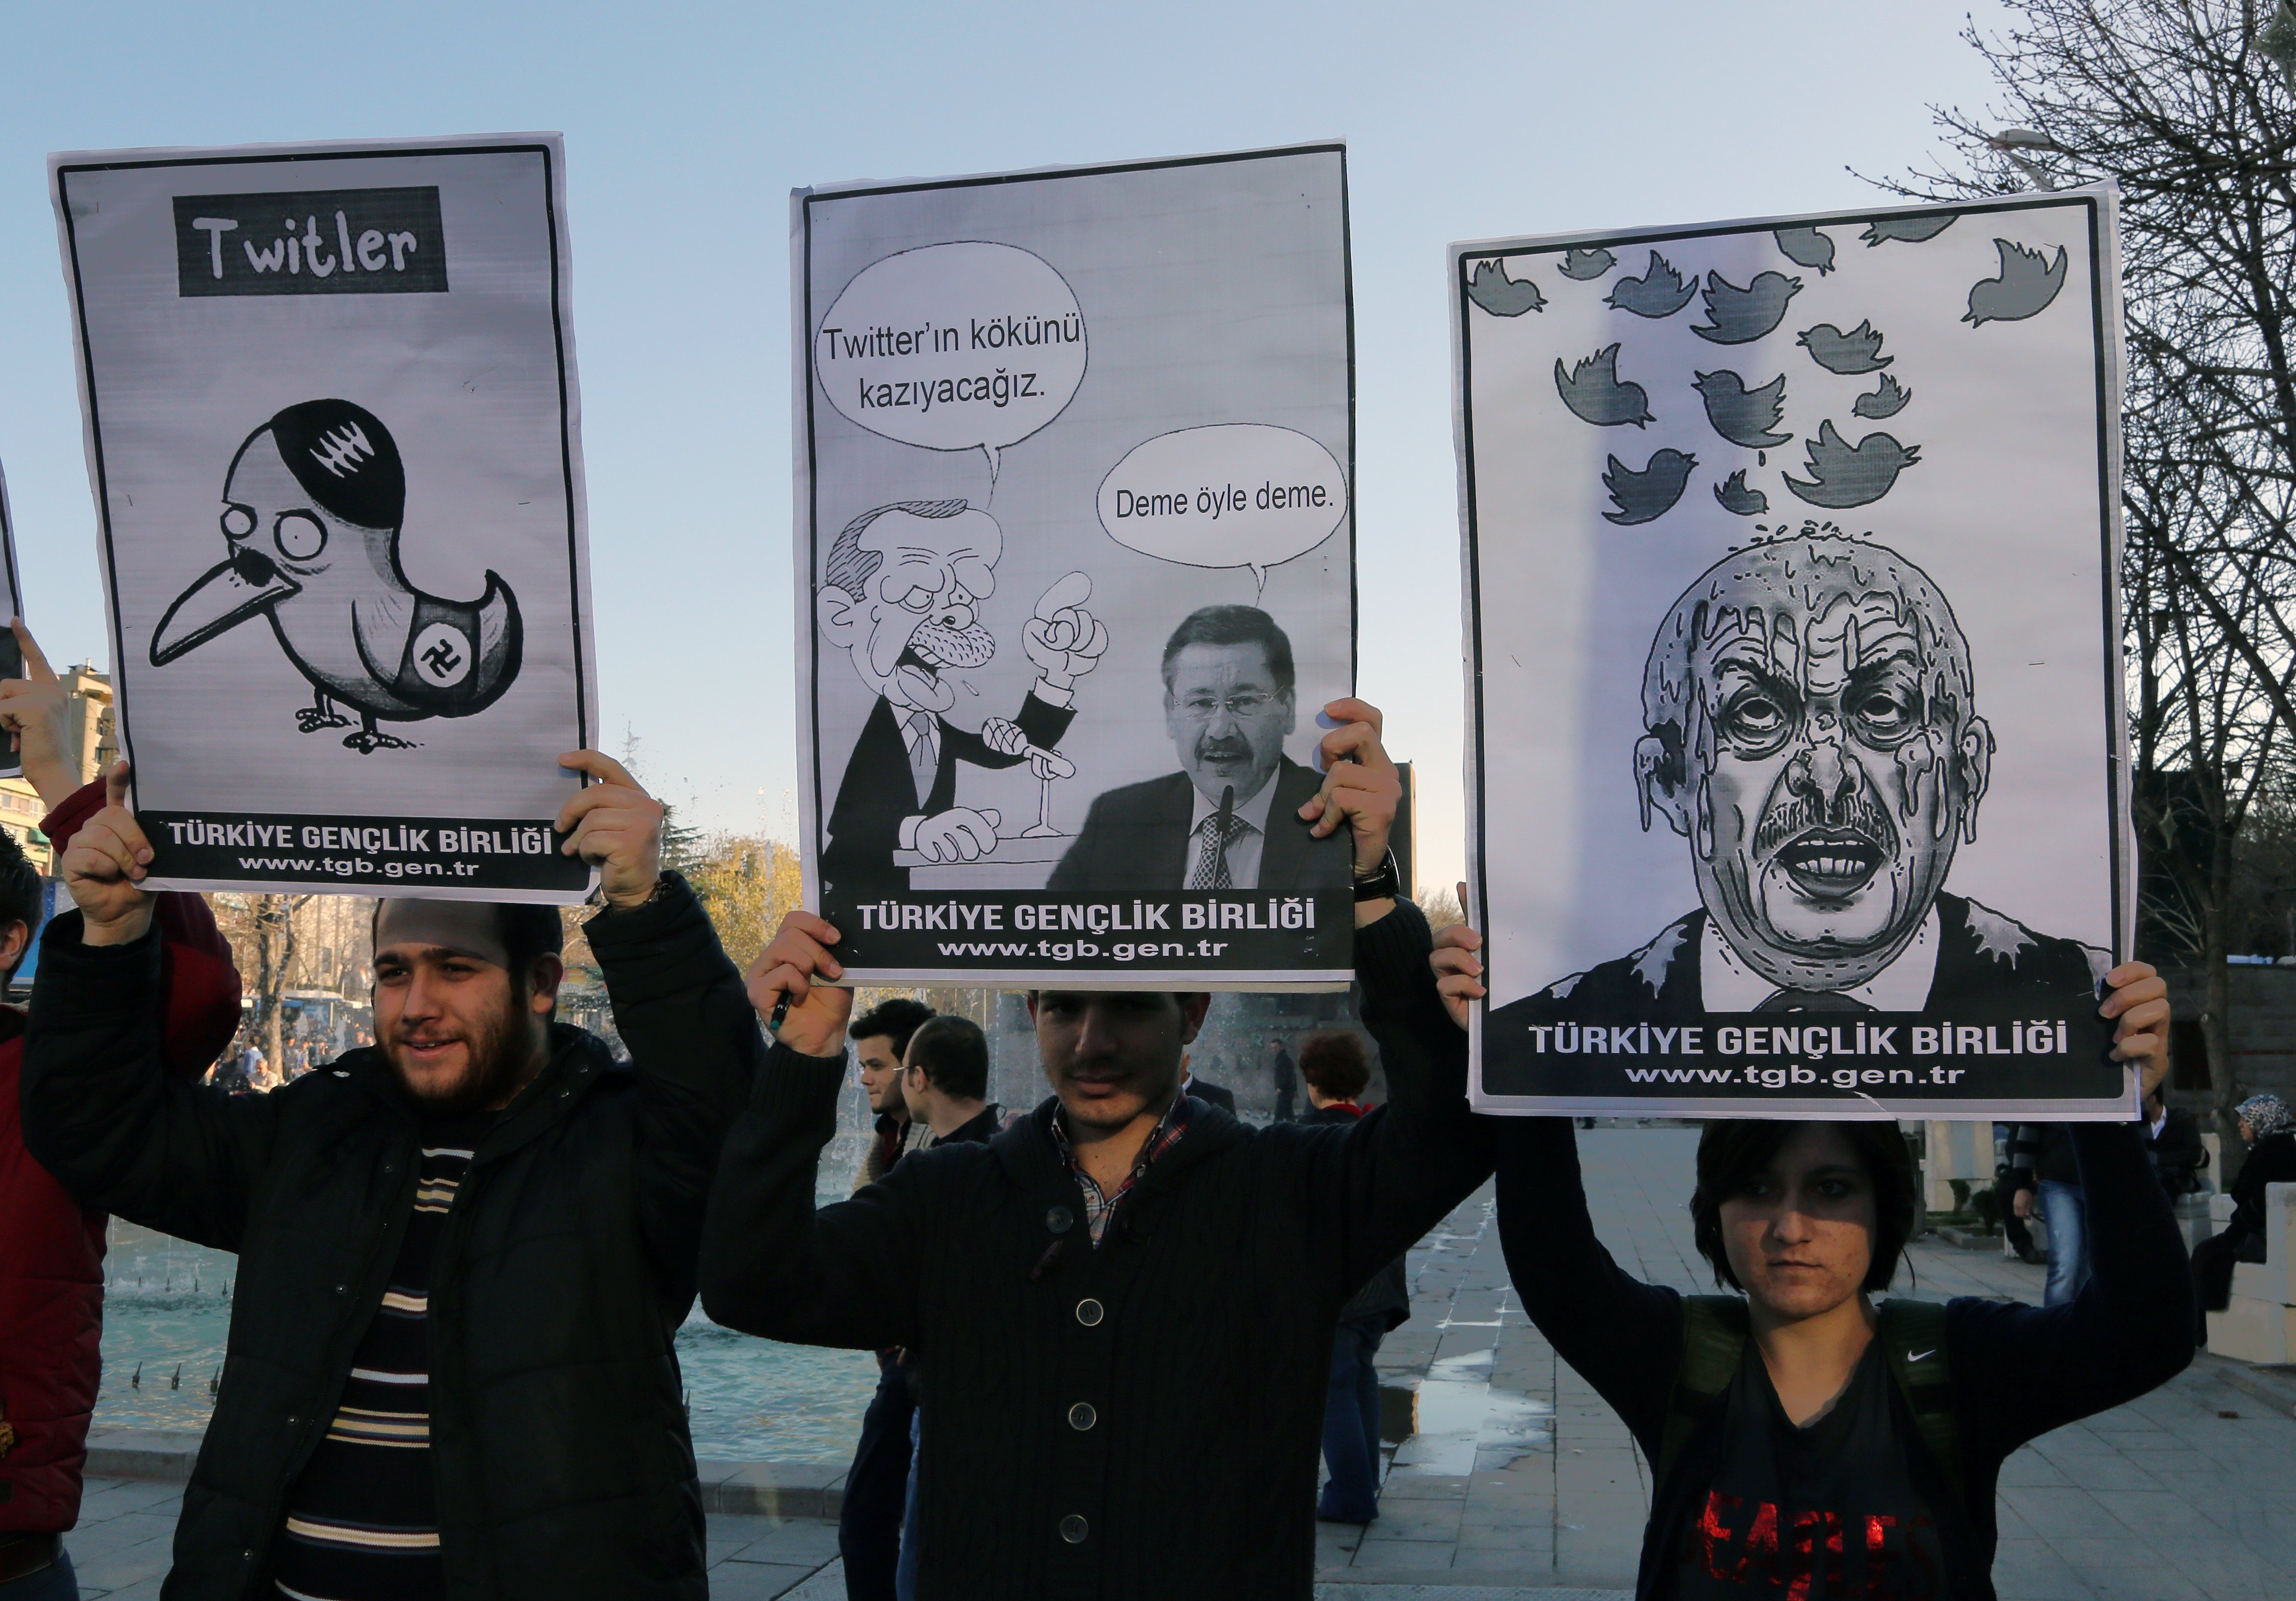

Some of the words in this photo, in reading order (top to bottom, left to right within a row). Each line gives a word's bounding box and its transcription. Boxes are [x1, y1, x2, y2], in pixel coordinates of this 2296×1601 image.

[193, 210, 417, 279] Twitler
[971, 312, 1080, 350] kökünü
[860, 368, 1045, 413] kazıyacağız.
[1117, 490, 1188, 518] Deme
[1197, 483, 1247, 520] öyle
[1256, 480, 1333, 510] deme.
[168, 819, 294, 847] TÜRKİYE
[302, 824, 430, 855] GENÇLİK
[439, 826, 552, 855] BİRLİĞİ
[238, 857, 480, 878] www.tgb.gen.tr
[856, 900, 1003, 930] TÜRKİYE
[1014, 900, 1170, 935] GENÇLİK
[1182, 897, 1315, 930] BİRLİĞİ
[937, 939, 1229, 961] www.tgb.gen.tr
[1529, 1022, 1704, 1054] TÜRKİYE
[1717, 1022, 1898, 1060] GENÇLİK
[1911, 1020, 2067, 1054] BİRLİĞİ
[1624, 1064, 1966, 1088] www.tgb.gen.tr
